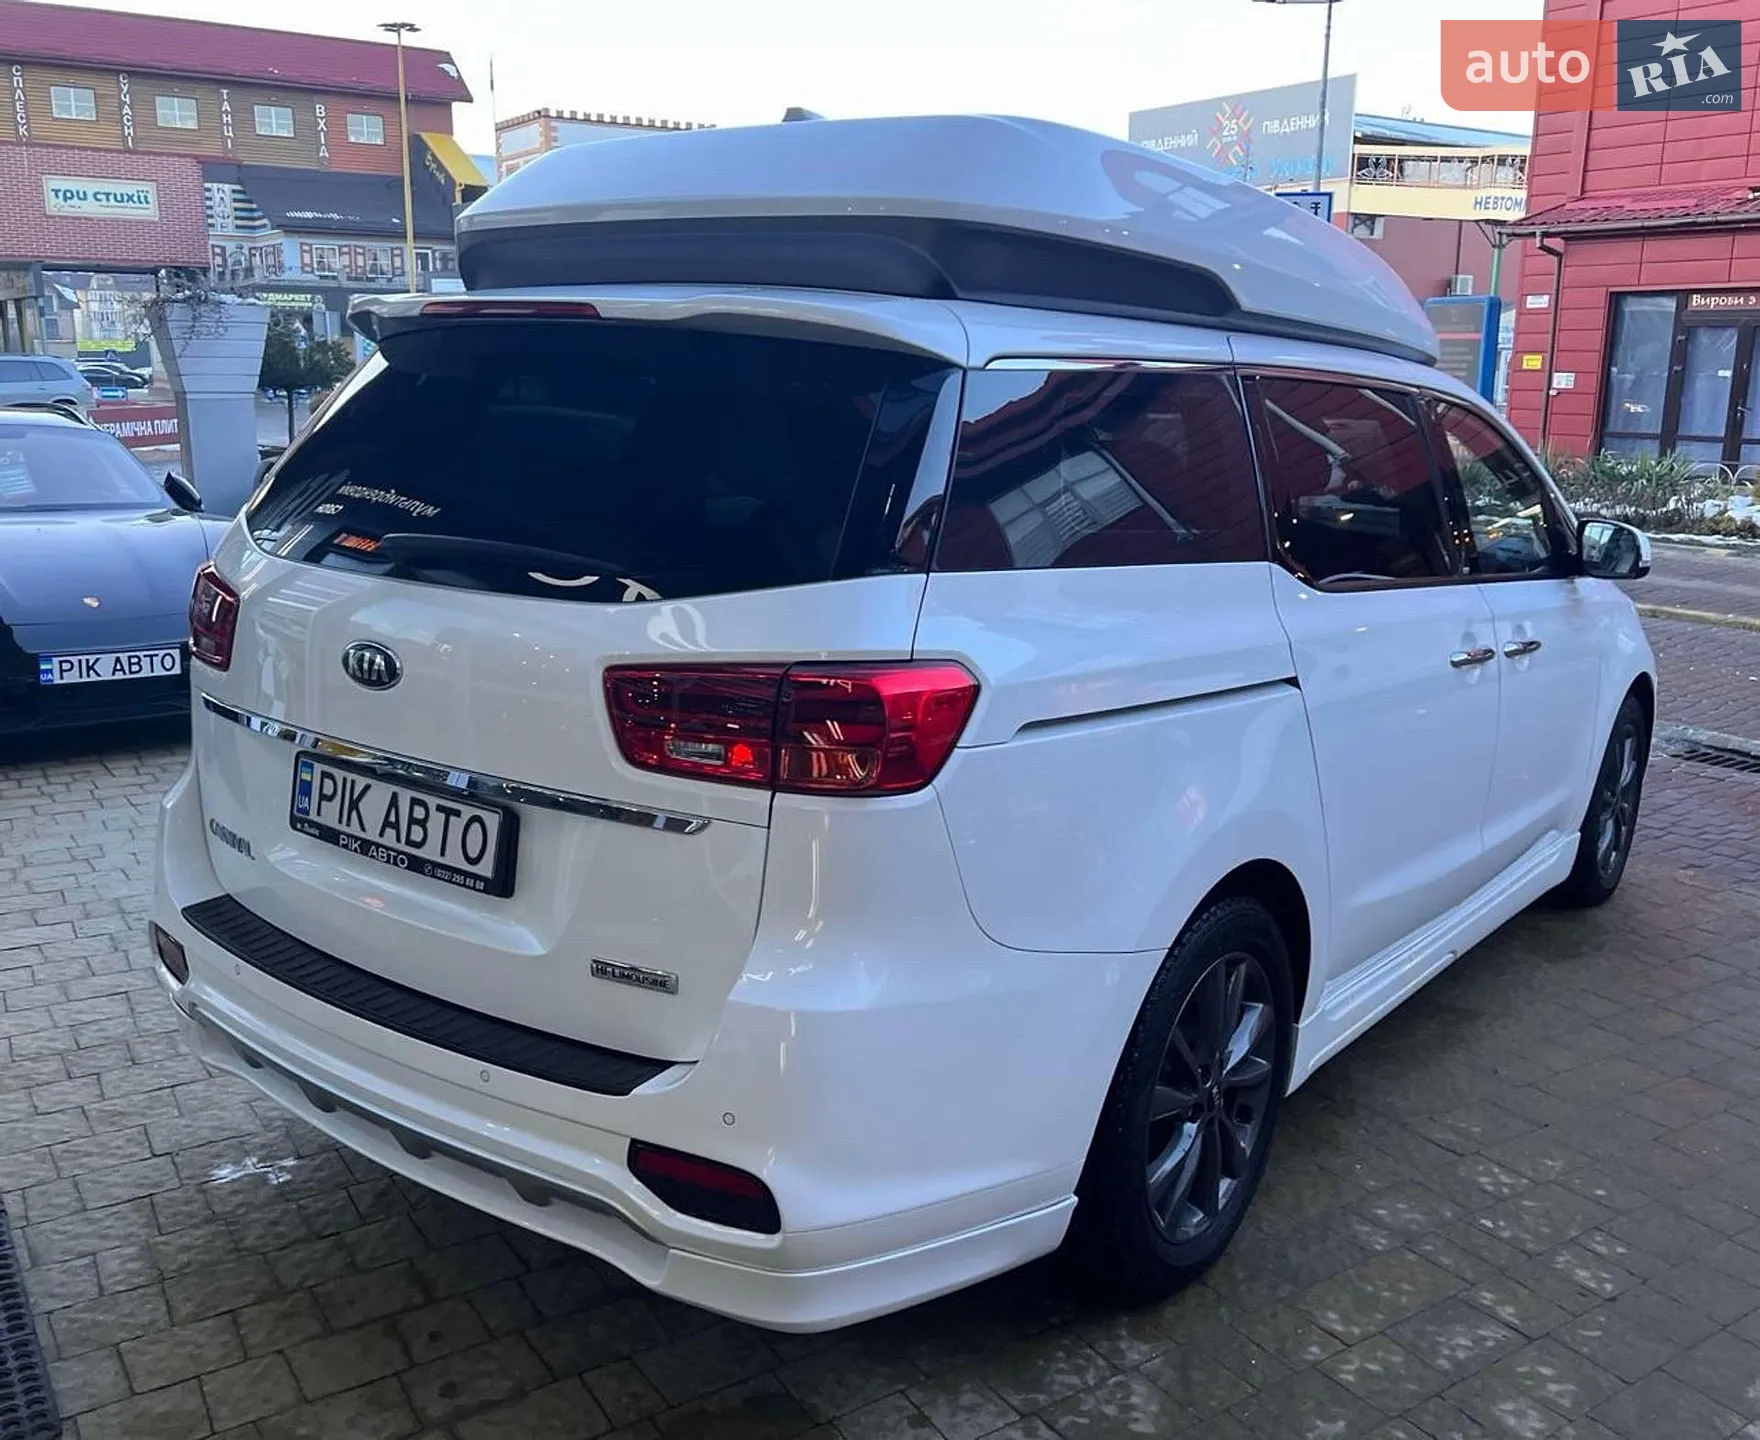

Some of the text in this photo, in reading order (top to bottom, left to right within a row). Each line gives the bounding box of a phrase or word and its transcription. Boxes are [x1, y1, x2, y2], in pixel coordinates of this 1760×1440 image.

[12, 65, 28, 137] СПЛЕСК
[119, 73, 133, 149] СУЧАСНІ
[220, 89, 234, 149] ТАНЦІ
[315, 104, 329, 158] ВХІД
[1222, 121, 1238, 137] 25
[51, 188, 150, 205] три стихії
[1473, 195, 1525, 212] НЕВТОМ
[1692, 294, 1744, 309] Вироби
[348, 648, 390, 683] KIA
[40, 673, 53, 681] UA
[297, 794, 310, 810] UA
